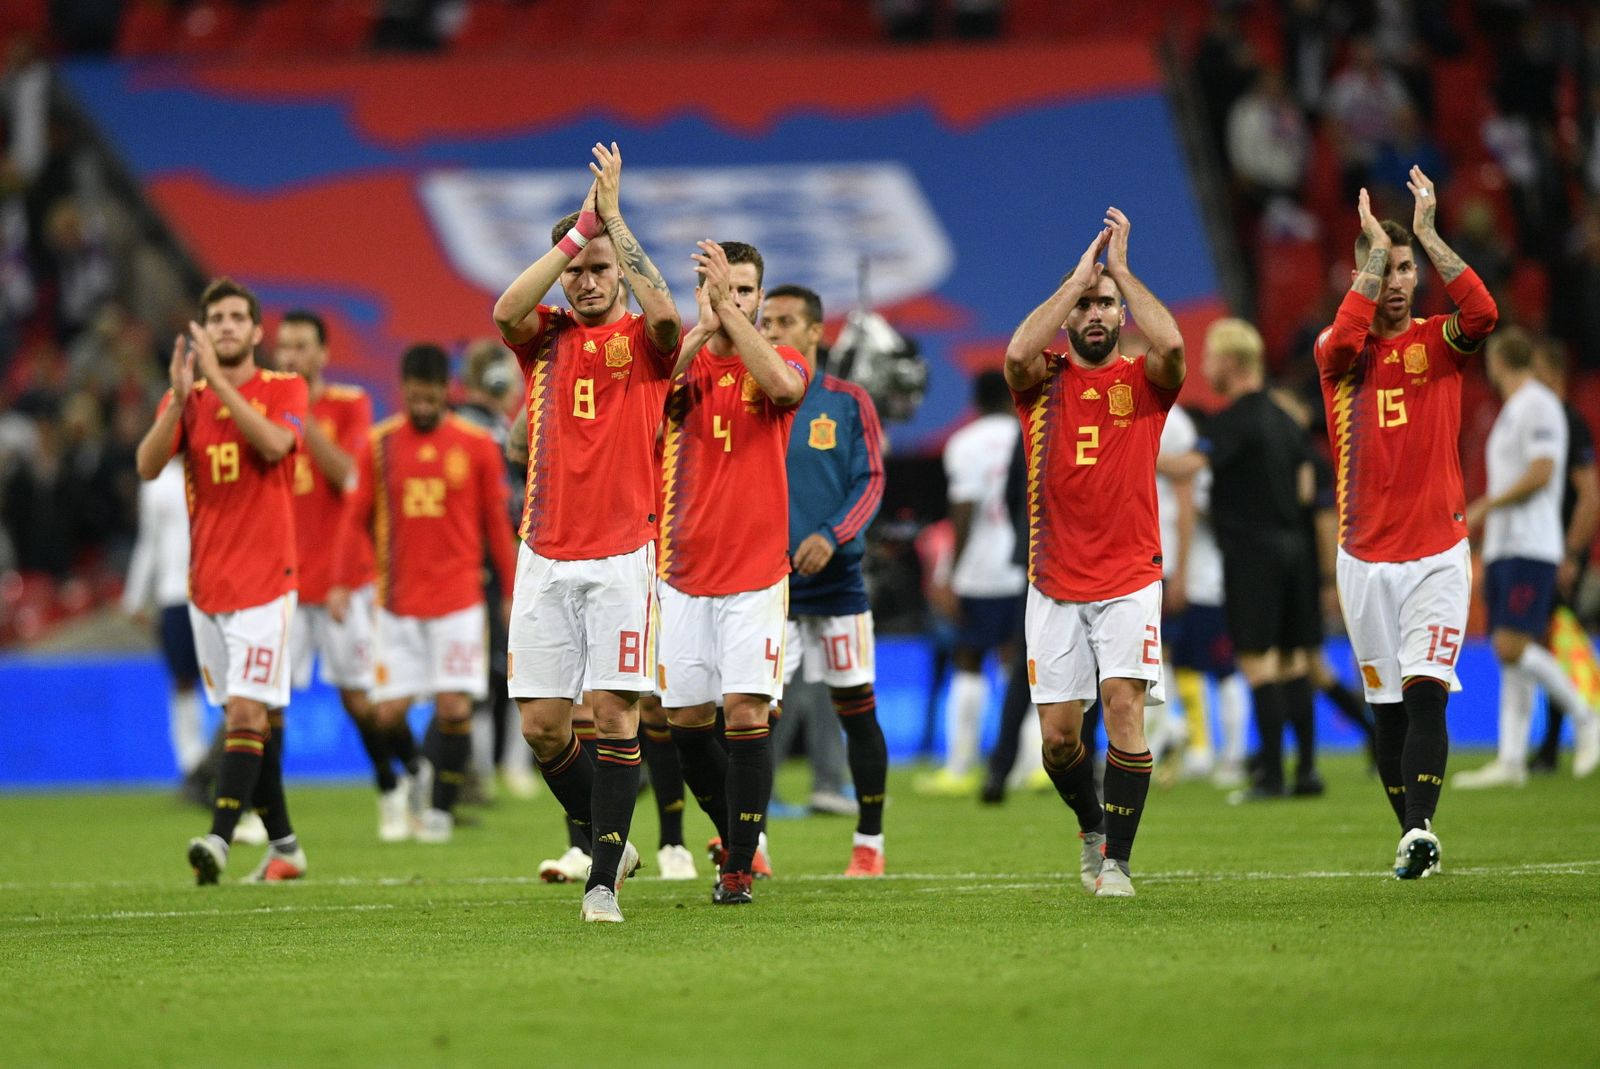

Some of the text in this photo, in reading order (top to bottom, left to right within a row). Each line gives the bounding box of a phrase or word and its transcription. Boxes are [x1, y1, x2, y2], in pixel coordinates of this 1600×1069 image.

[573, 378, 596, 420] 8
[1377, 388, 1408, 428] 15
[713, 415, 731, 452] 4
[1076, 426, 1099, 465] 2
[206, 442, 240, 484] 19
[243, 645, 273, 685] 19
[619, 630, 640, 673] 8
[765, 638, 780, 679] 4
[821, 634, 852, 672] 10
[1142, 624, 1160, 665] 2
[1426, 625, 1460, 667] 15
